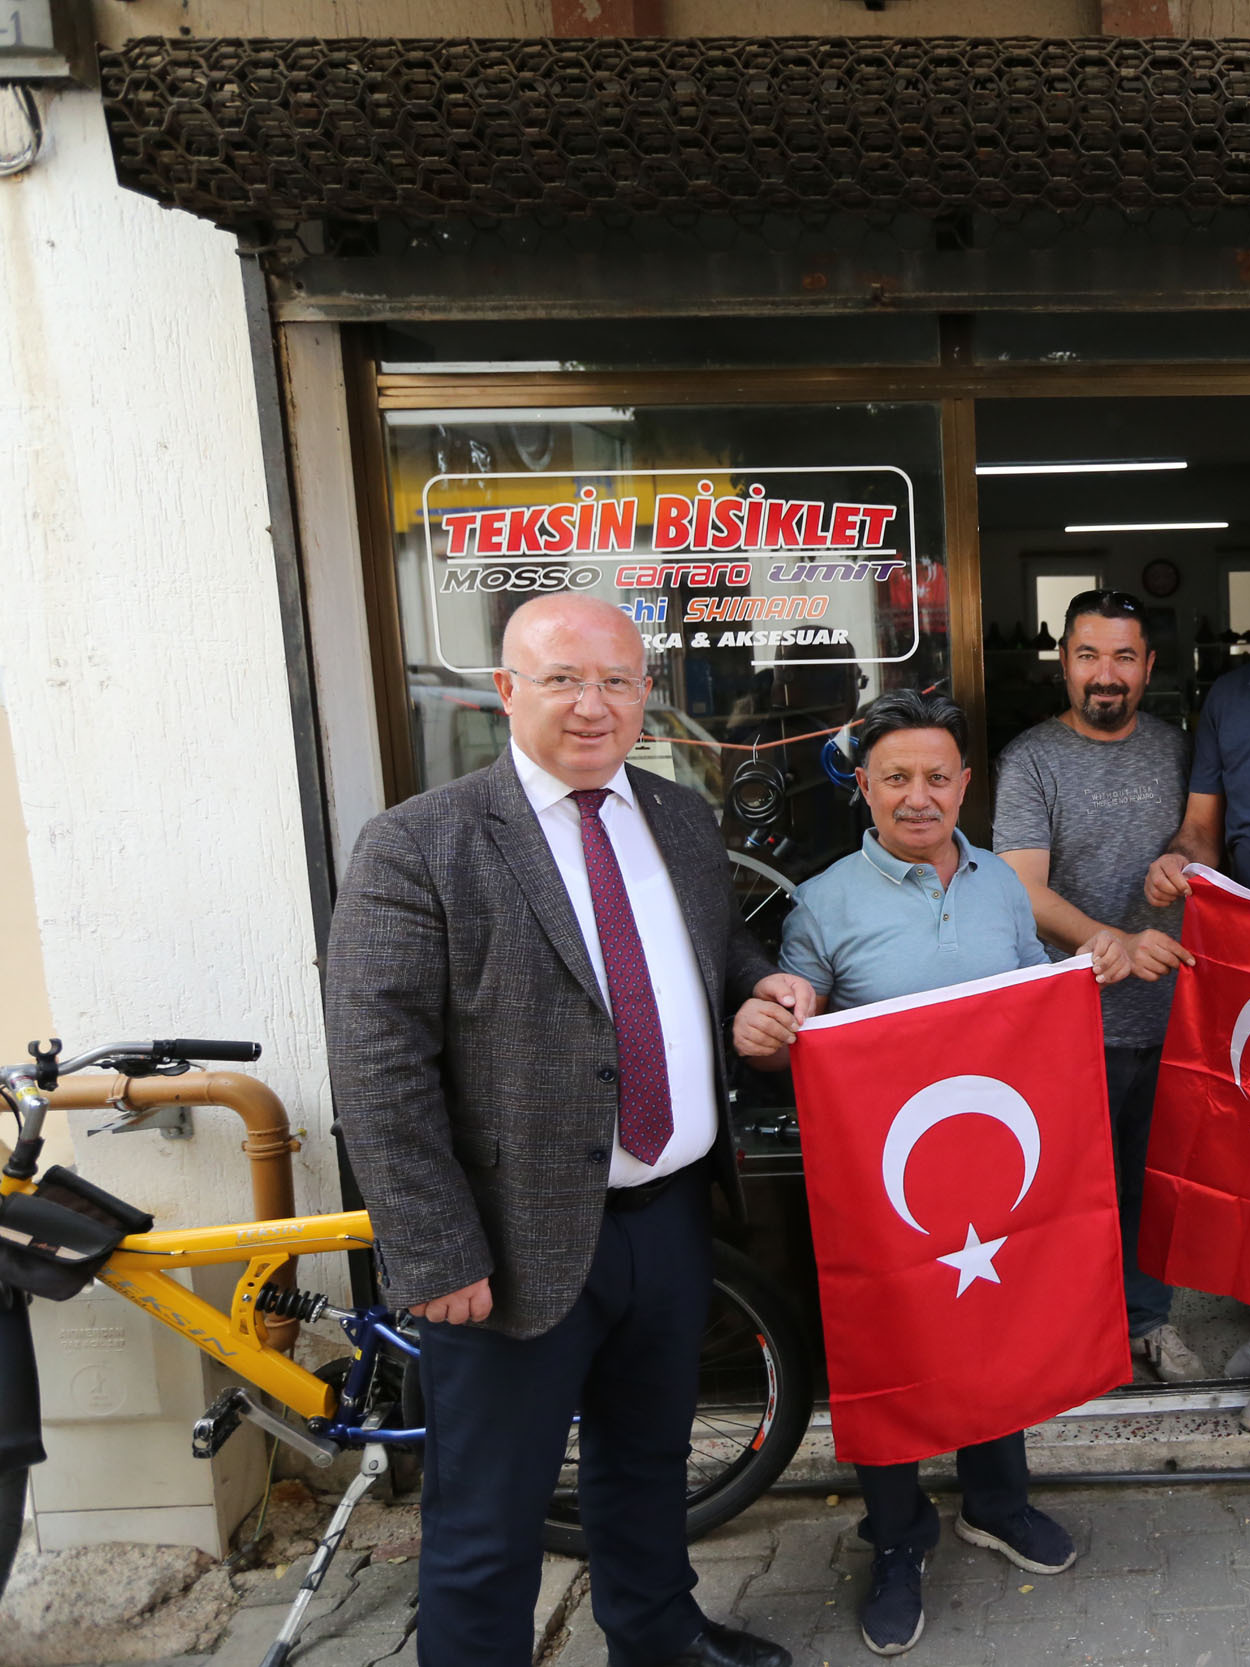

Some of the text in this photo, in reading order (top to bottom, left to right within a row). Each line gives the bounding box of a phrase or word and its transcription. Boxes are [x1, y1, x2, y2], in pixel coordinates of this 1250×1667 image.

[442, 479, 897, 556] TEKSİN BİSİKLET
[440, 566, 602, 593] MOSSO
[683, 595, 830, 623] SHIMANO
[691, 631, 711, 648] &
[717, 629, 849, 648] AKSESUAR
